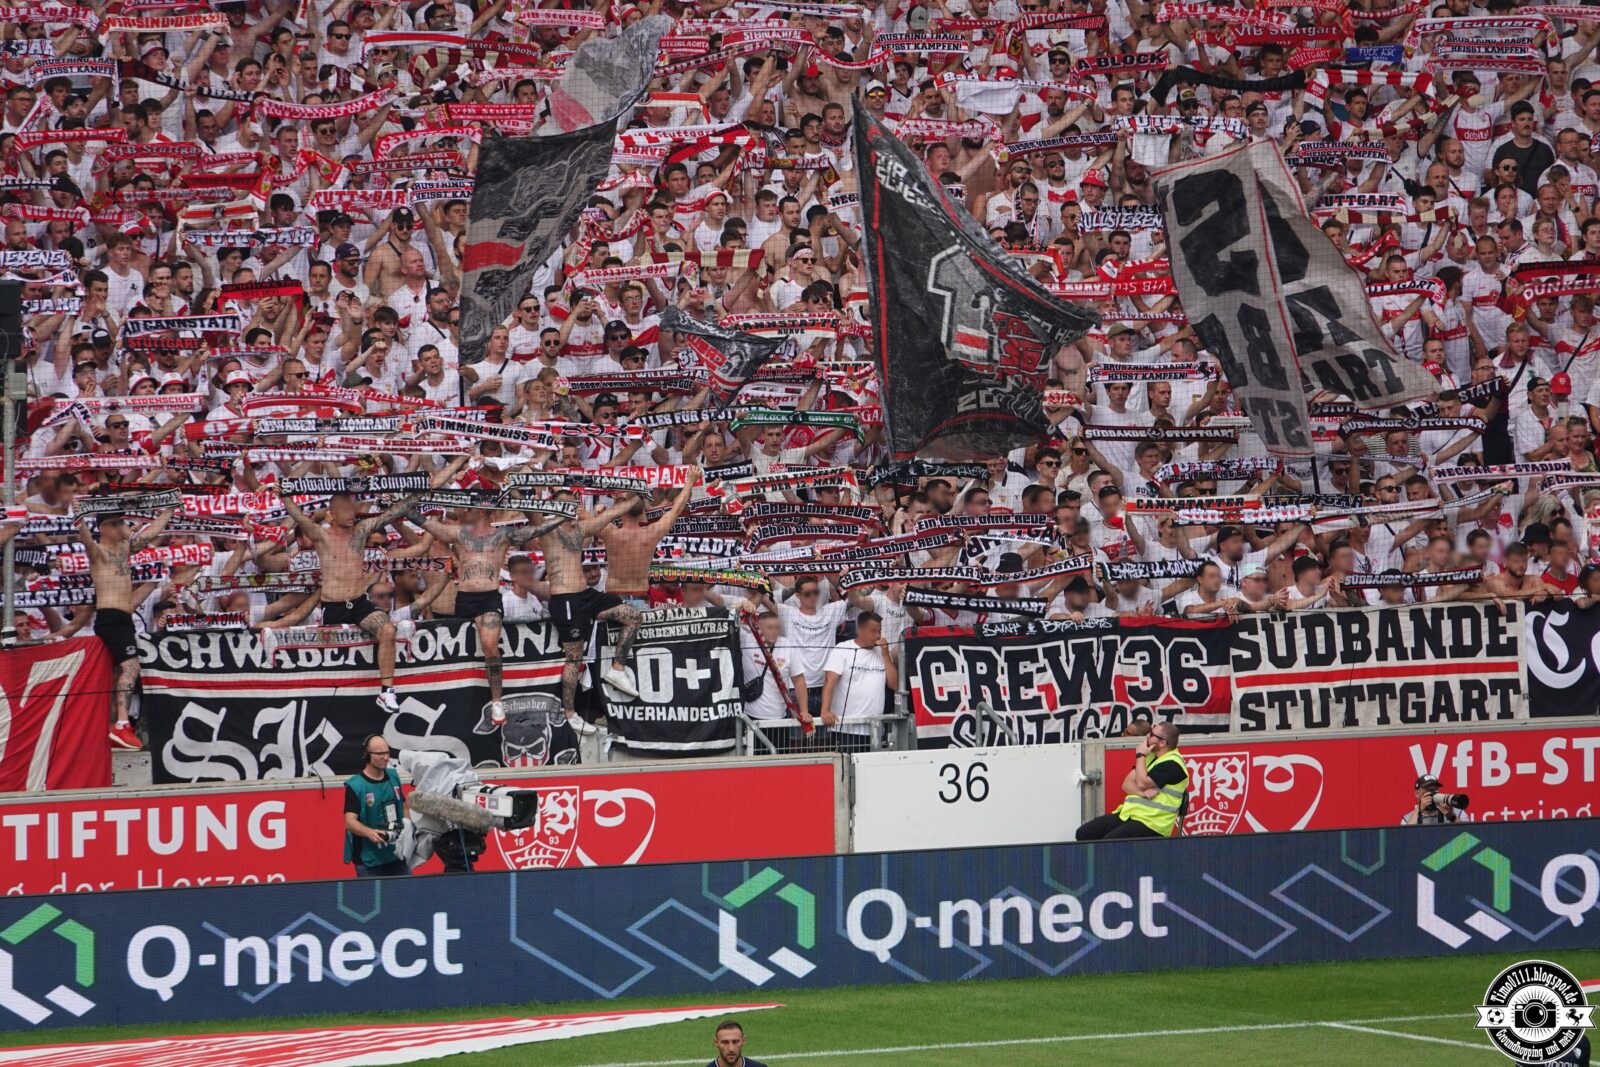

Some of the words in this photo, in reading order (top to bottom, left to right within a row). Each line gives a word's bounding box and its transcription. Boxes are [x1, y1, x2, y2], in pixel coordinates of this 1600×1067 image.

[1100, 53, 1166, 68] BLOCK
[355, 158, 456, 173] STUTTGART
[282, 477, 346, 493] Schwaben
[1136, 497, 1244, 509] CANNSTATTER
[666, 606, 708, 621] ALLEN
[691, 621, 728, 634] ULTRAS
[1231, 602, 1519, 673] SÜDBANDE
[915, 635, 1212, 717] CREW36
[607, 702, 744, 722] UNVERHANDELBAR
[1240, 678, 1521, 732] STUTTGART
[938, 762, 990, 804] 36
[3, 801, 288, 862] TIFTUNG
[549, 835, 560, 845] 93
[846, 876, 1168, 963] Q-nnect
[127, 912, 464, 1001] Q-nnect
